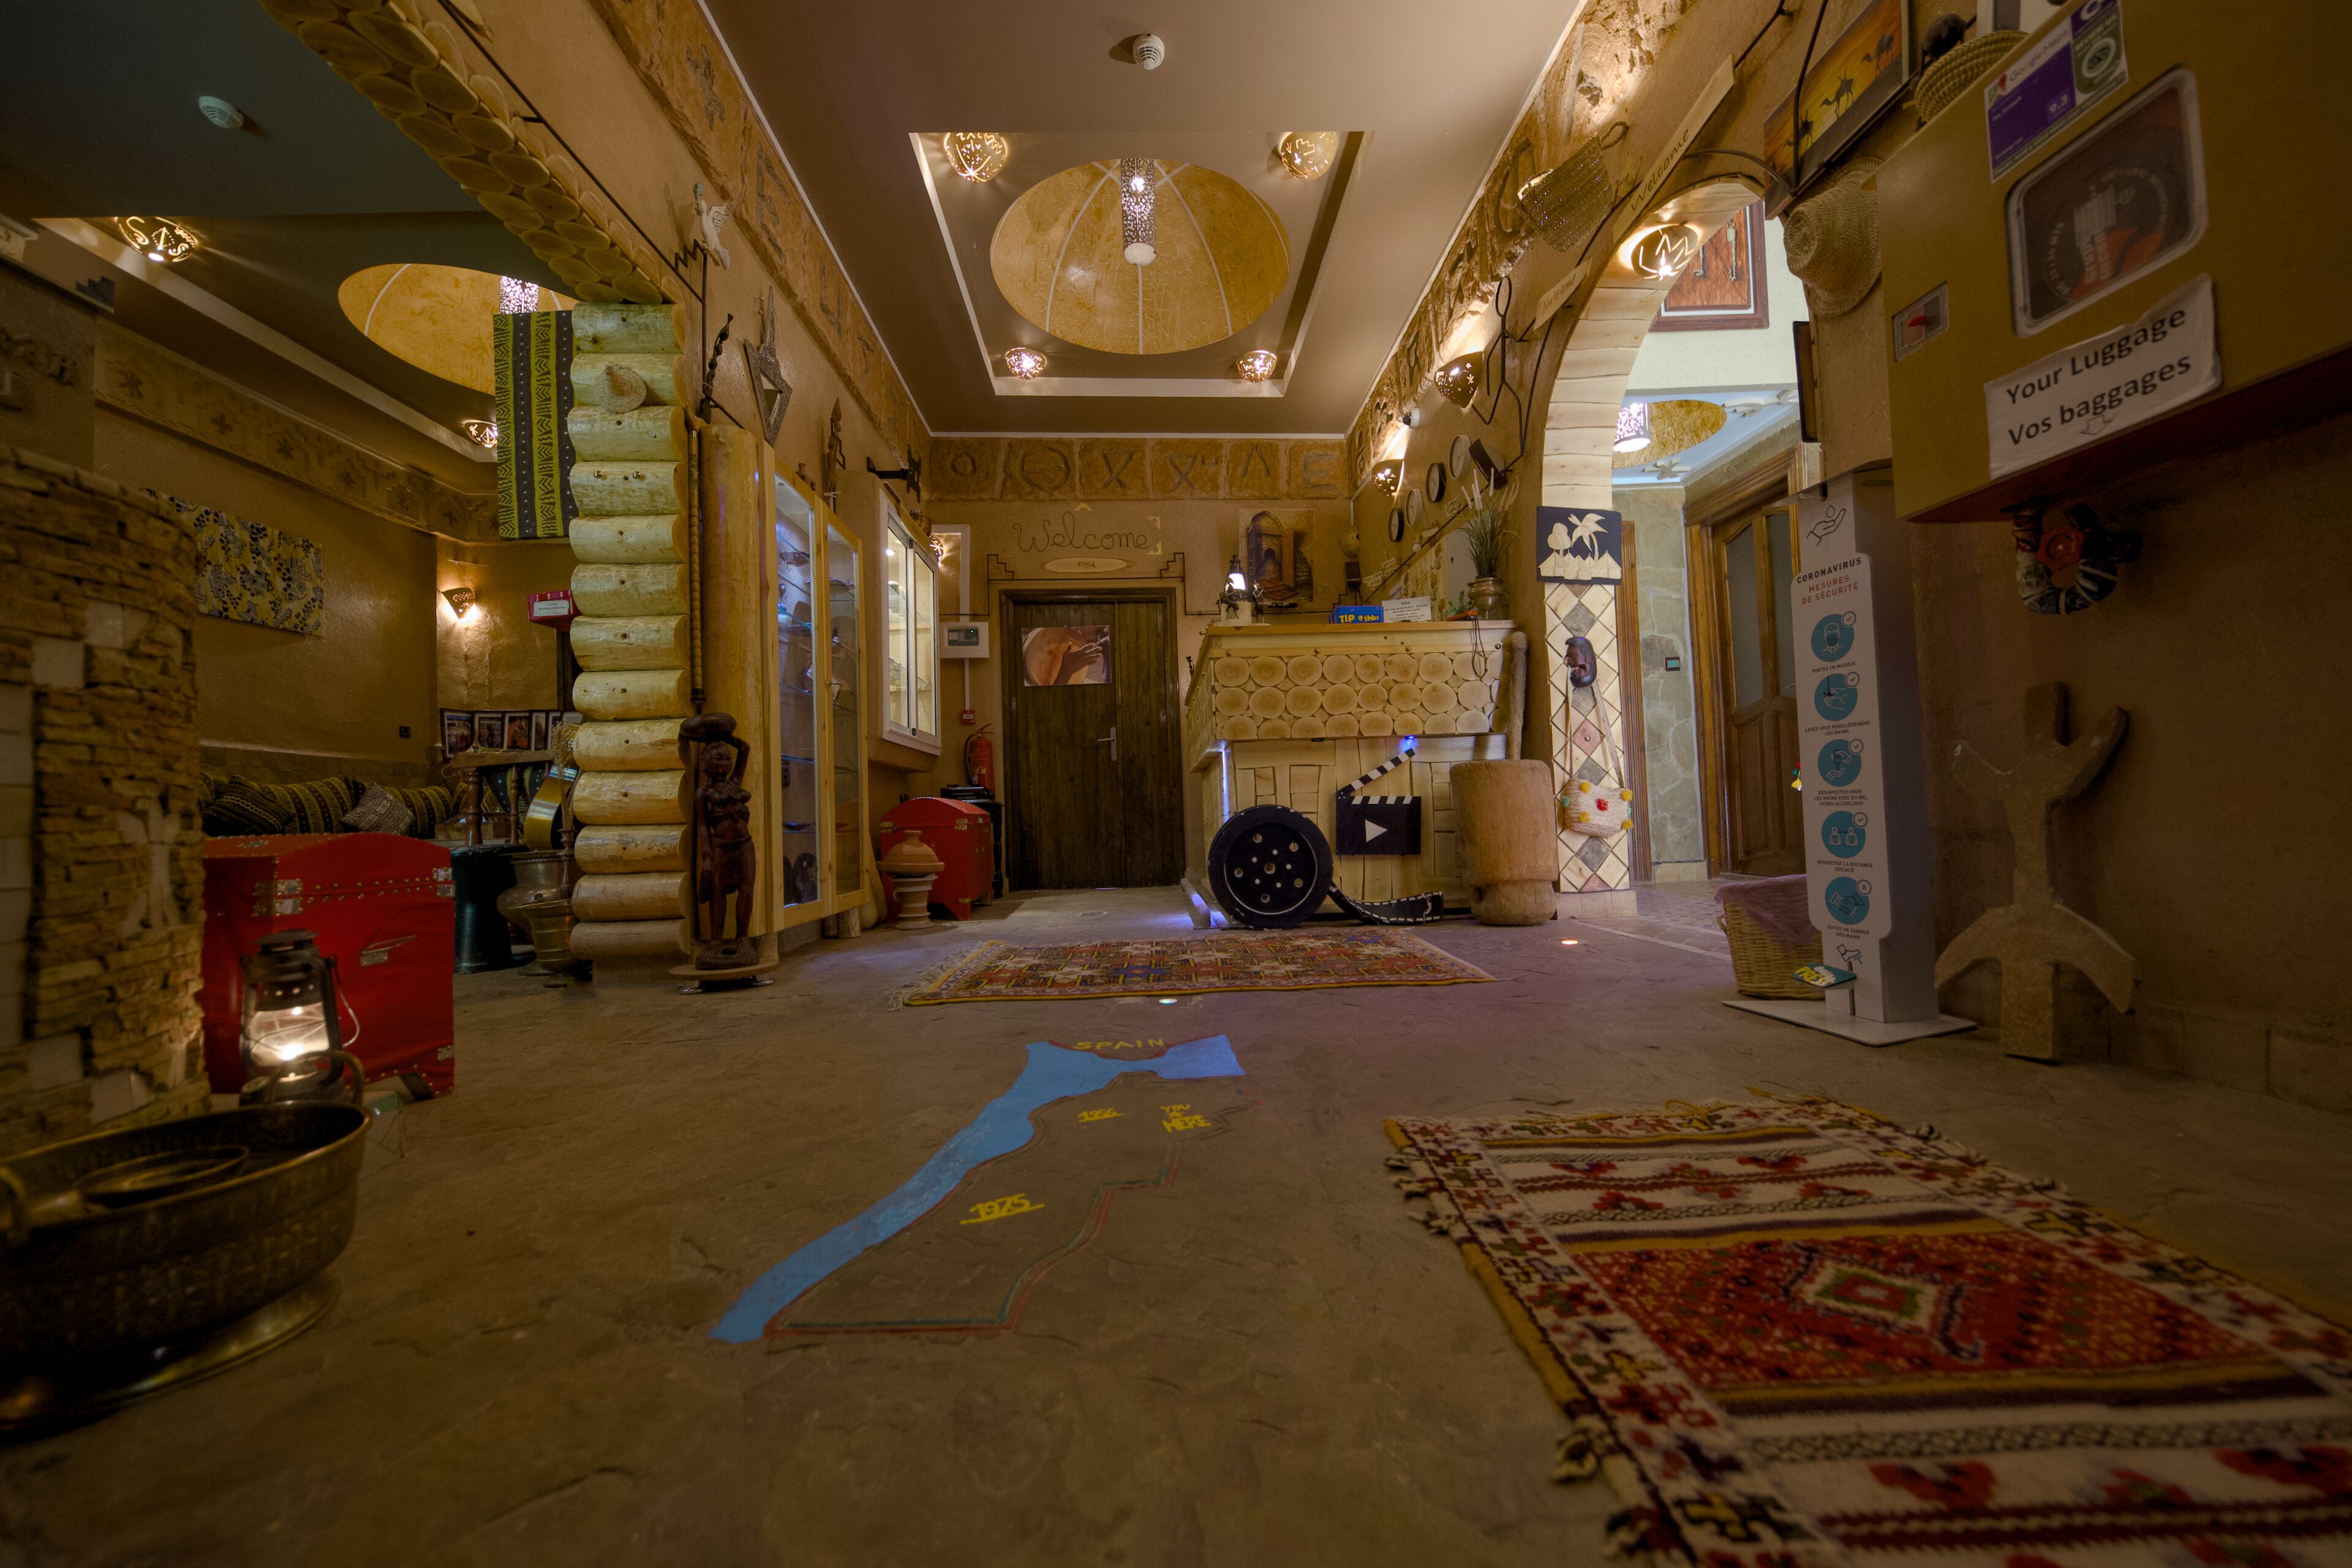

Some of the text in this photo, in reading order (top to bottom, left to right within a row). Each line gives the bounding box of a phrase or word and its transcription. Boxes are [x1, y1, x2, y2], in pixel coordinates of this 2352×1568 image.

[2049, 94, 2068, 115] 9.3
[1631, 129, 1689, 211] Welcome
[2006, 309, 2185, 405] Your Luggage
[2008, 356, 2191, 445] Vos baggages
[1012, 511, 1149, 552] Welcome
[1797, 557, 1861, 584] CORONAVIRUS
[1802, 580, 1859, 605] DE SÉCURITÉ
[1809, 575, 1850, 593] MESURES
[1339, 614, 1355, 623] TIP
[1073, 1038, 1164, 1050] SPAIN
[1162, 1115, 1212, 1133] HERE
[969, 1193, 1031, 1219] 1975
